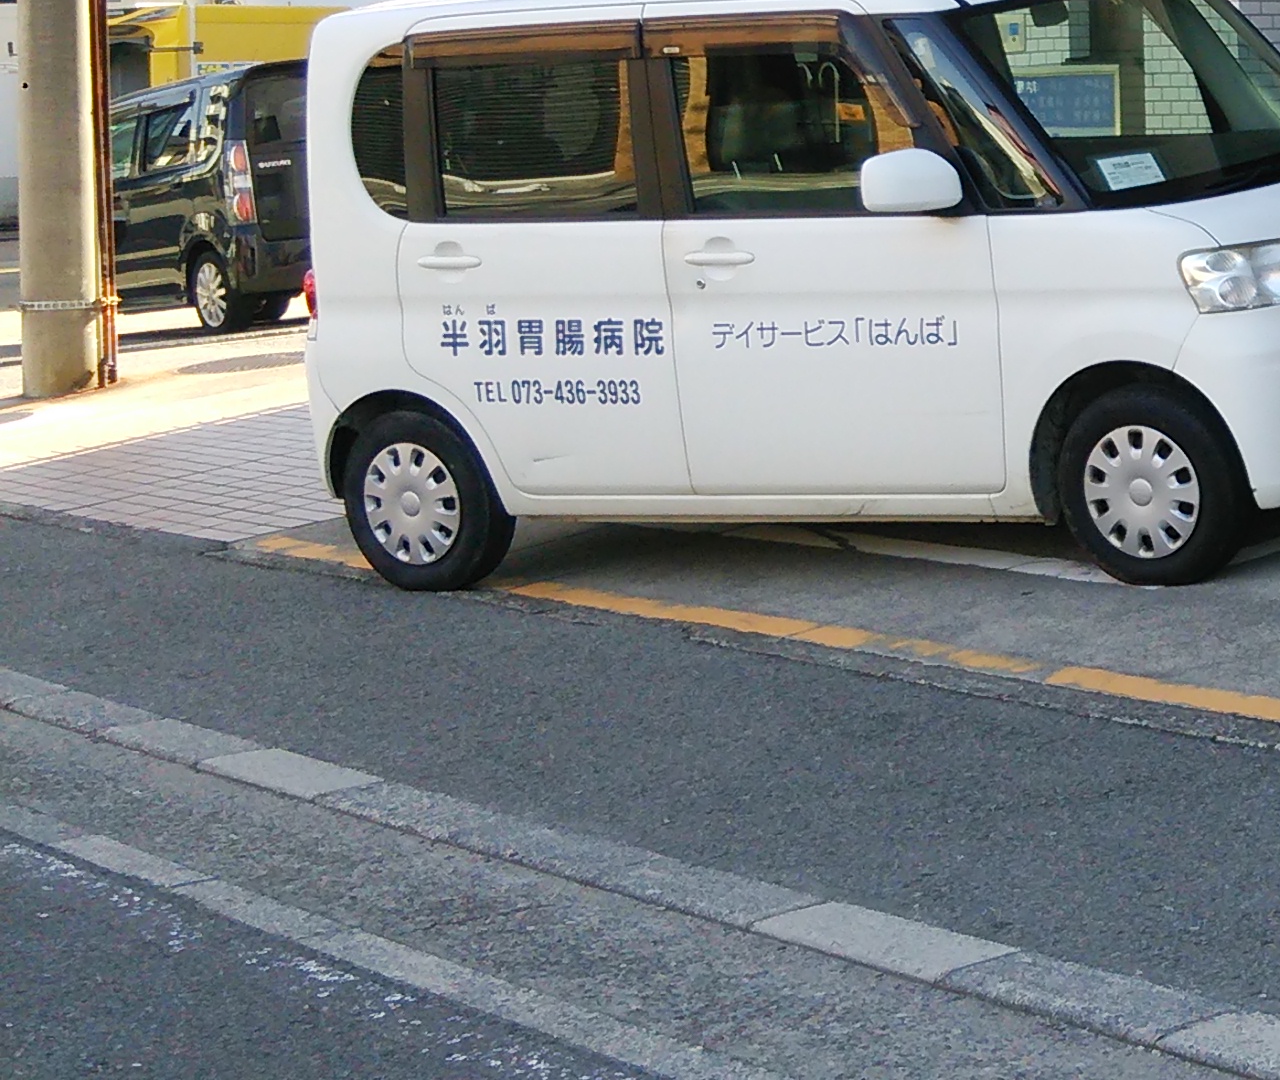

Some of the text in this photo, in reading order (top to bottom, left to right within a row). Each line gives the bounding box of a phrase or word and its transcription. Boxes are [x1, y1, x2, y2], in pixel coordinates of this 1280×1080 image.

[440, 318, 665, 357] 半羽胃腸病院
[711, 315, 959, 350] デイサービス「はんば」
[473, 379, 641, 405] TEL 073-436-3933
